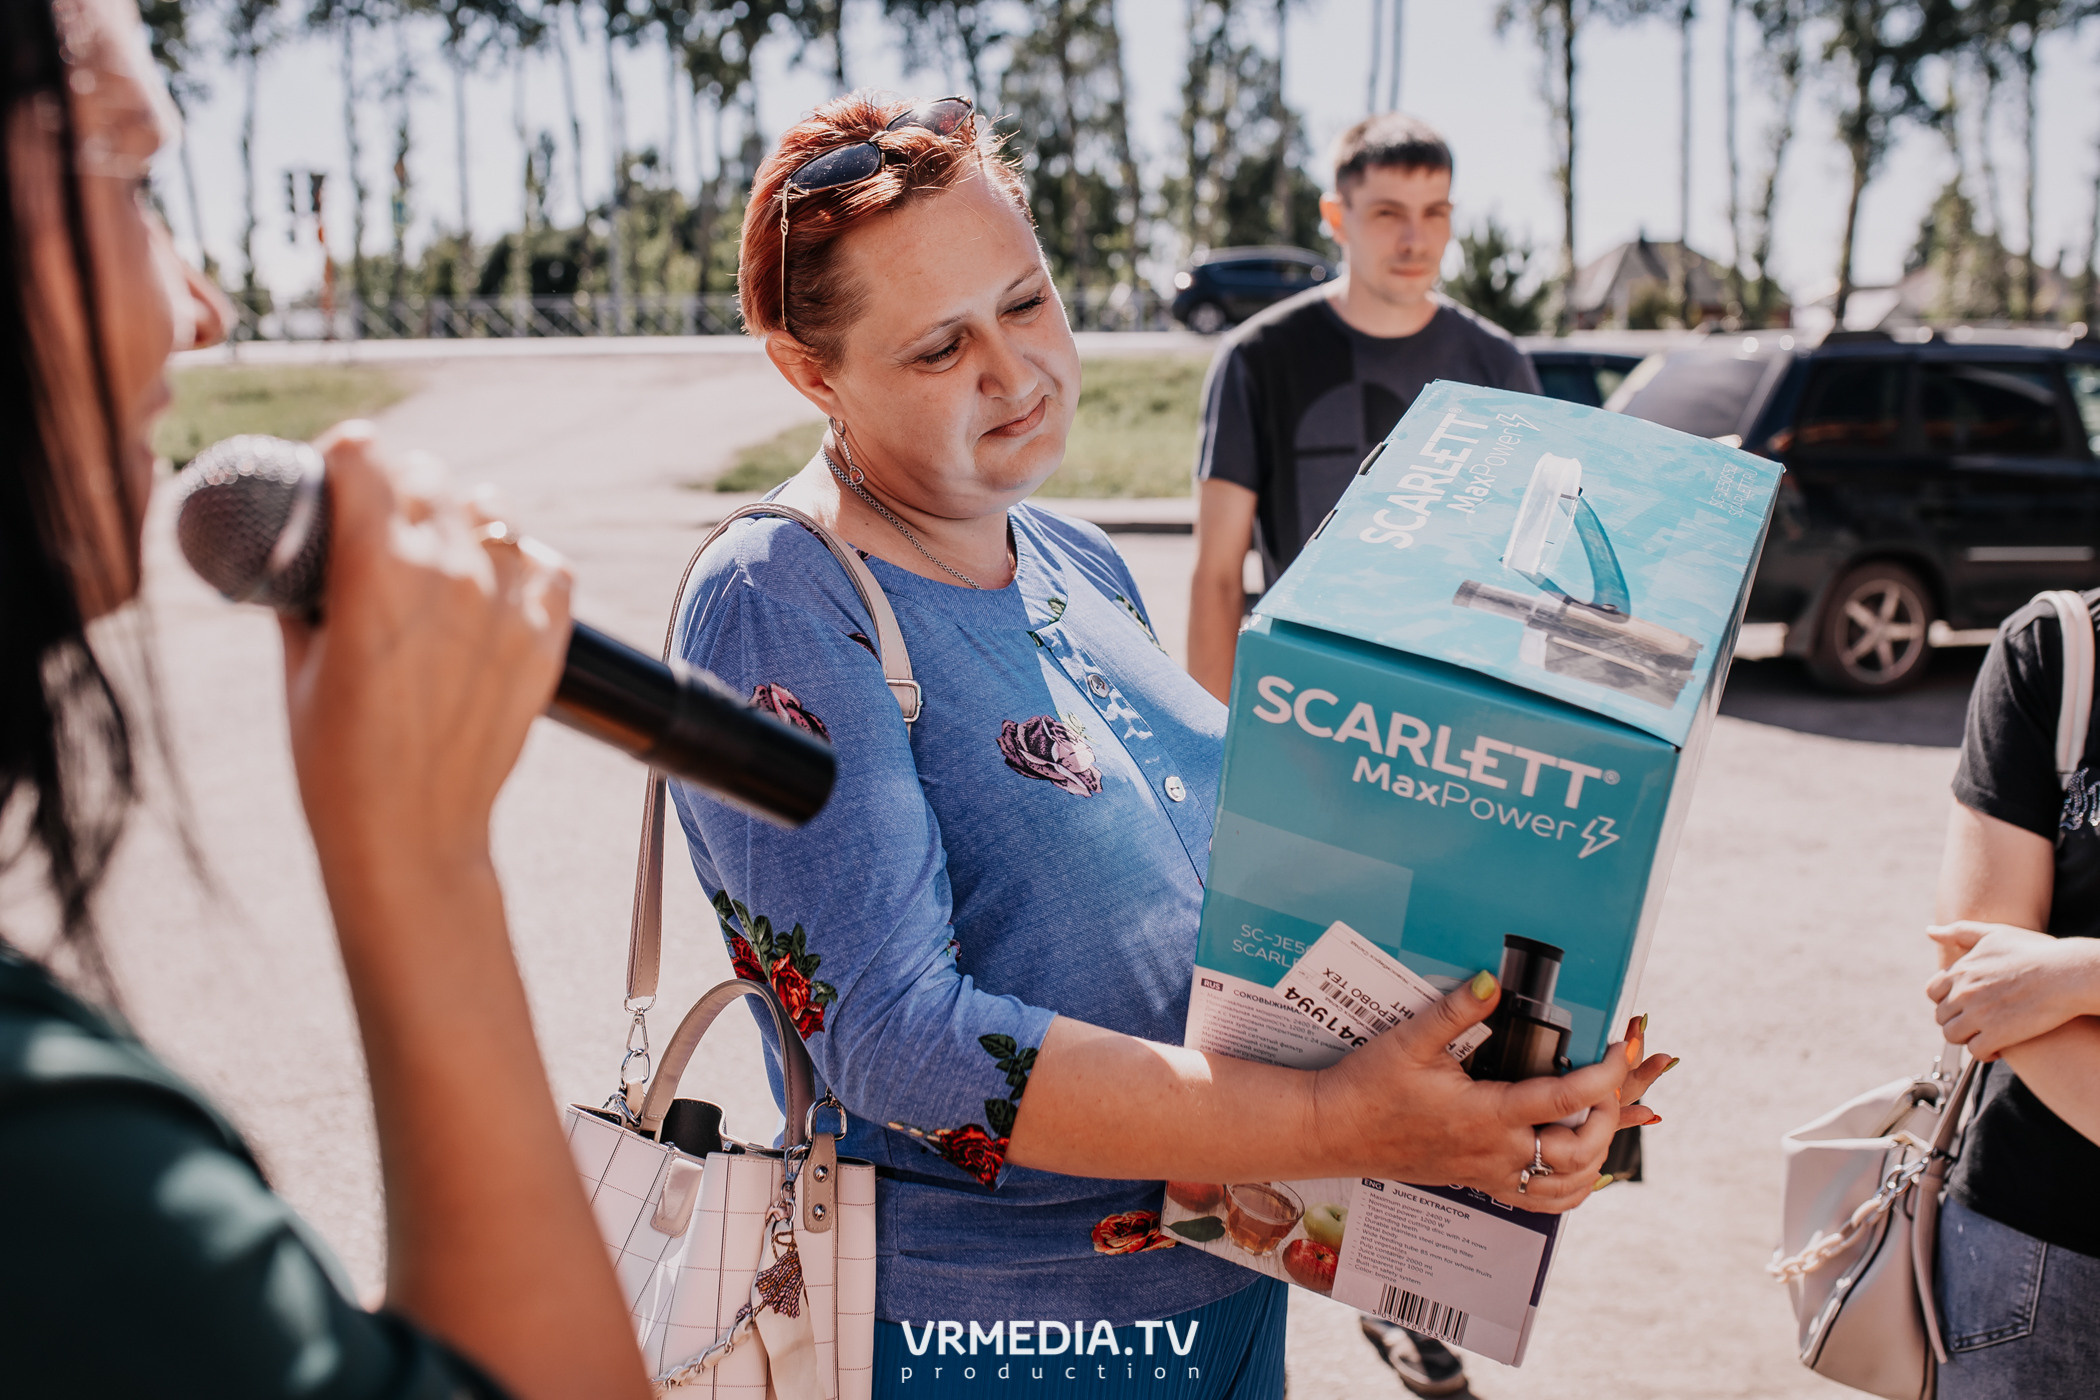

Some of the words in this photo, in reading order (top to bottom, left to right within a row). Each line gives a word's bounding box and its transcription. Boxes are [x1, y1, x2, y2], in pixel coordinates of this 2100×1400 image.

[1359, 412, 1477, 550] SCARLETT
[1448, 424, 1525, 515] MaxPower
[1252, 675, 1602, 810] SCARLETT
[1353, 756, 1575, 841] MaxPower
[1203, 979, 1220, 990] RUS
[1232, 988, 1306, 1016] СОКОВЫЖИМА
[1289, 1024, 1305, 1033] 1200
[1293, 1018, 1310, 1028] 2400
[1365, 1178, 1383, 1189] ENG
[1368, 1198, 1396, 1212] Nominal
[1419, 1216, 1437, 1226] 1200
[1369, 1192, 1401, 1207] Maximum
[1425, 1211, 1443, 1221] 2400
[1391, 1188, 1417, 1201] JUICE
[1419, 1197, 1470, 1220] EXTRACTOR
[1363, 1222, 1380, 1232] Metal
[1381, 1229, 1398, 1239] body
[1367, 1204, 1383, 1214] Titan
[1384, 1210, 1407, 1222] coated
[1407, 1218, 1430, 1231] cutting
[1431, 1227, 1444, 1235] disc
[1445, 1232, 1460, 1241] with
[1470, 1241, 1487, 1250] rows
[1373, 1213, 1400, 1227] grinding
[1400, 1223, 1418, 1233] teeth
[1364, 1216, 1389, 1229] Durable
[1389, 1225, 1417, 1239] stainless
[1418, 1235, 1434, 1244] steel
[1434, 1241, 1458, 1254] grating
[1458, 1249, 1473, 1258] filter
[1372, 1239, 1407, 1255] vegetables
[1357, 1253, 1393, 1270] Transparent
[1358, 1240, 1374, 1250] Pulp
[1374, 1246, 1404, 1260] container
[1405, 1257, 1423, 1266] 2000
[1358, 1246, 1375, 1256] Juice
[1376, 1253, 1406, 1267] container
[1406, 1263, 1423, 1273] 1000
[1361, 1228, 1378, 1238] Wide
[1378, 1234, 1403, 1248] feeding
[1403, 1243, 1418, 1252] tube
[1453, 1261, 1474, 1272] whole
[1475, 1268, 1492, 1278] fruits
[1372, 1270, 1396, 1282] bronze
[1379, 1266, 1398, 1278] safety
[1398, 1273, 1421, 1286] system
